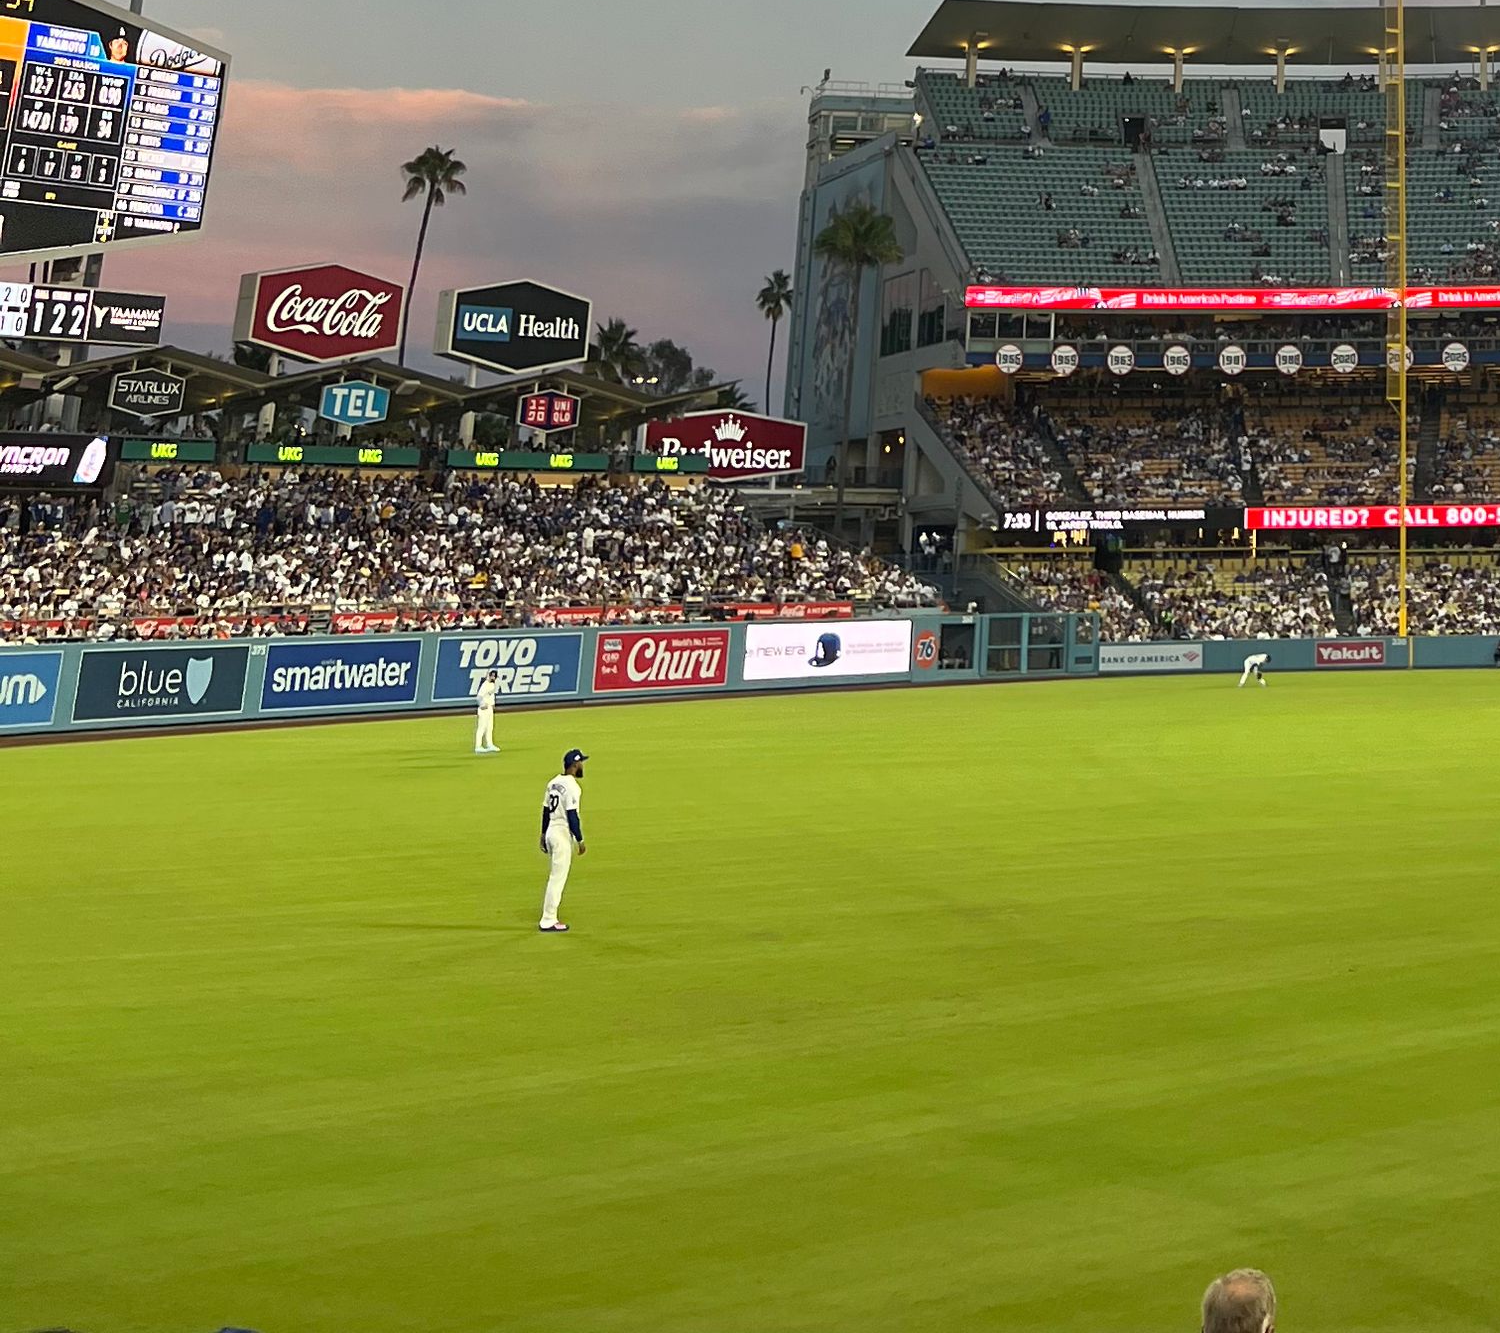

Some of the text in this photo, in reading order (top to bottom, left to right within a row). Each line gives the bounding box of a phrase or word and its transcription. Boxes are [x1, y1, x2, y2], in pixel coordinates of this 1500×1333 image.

[69, 71, 84, 82] ERA
[30, 75, 122, 105] 12-7 2.63 0.90
[60, 114, 79, 133] 139
[97, 119, 113, 138] 34
[4, 287, 28, 303] 2 0
[1143, 293, 1257, 305] Drink in America's Pastime
[1439, 291, 1463, 302] Drink
[1464, 292, 1472, 302] in
[33, 301, 85, 336] 1 2 2
[266, 283, 392, 340] Coca-Cola
[16, 317, 23, 332] 0
[463, 311, 579, 341] UCLA Health
[1054, 353, 1077, 366] 1959
[1109, 354, 1133, 366] 1963
[1165, 354, 1189, 366] 1965
[1221, 353, 1245, 366] 1981
[1333, 353, 1356, 364] 2020
[1388, 352, 1411, 364] 204
[1444, 352, 1467, 364] 2025
[117, 378, 181, 397] STARLUX
[125, 392, 171, 408] AIRLINES
[331, 388, 380, 420] TEL
[554, 400, 570, 411] UNI
[553, 412, 570, 422] QLO
[151, 443, 177, 459] UKG
[278, 446, 303, 462] UKG
[358, 448, 382, 464] UKG
[661, 437, 791, 469] Bdweiser
[475, 452, 499, 468] UKG
[550, 453, 573, 469] UKG
[657, 456, 678, 471] UKG
[1122, 510, 1168, 521] BASEMAN,
[1167, 510, 1205, 520] NUMBER
[1263, 508, 1370, 526] INJURED?
[1384, 507, 1439, 525] CALL
[460, 638, 537, 668] TOYO
[916, 636, 938, 660] 76
[1319, 645, 1382, 661] Yakult
[627, 637, 721, 682] Churu
[1101, 653, 1181, 664] BANK OF AMERICA
[118, 660, 183, 696] blue
[272, 658, 409, 693] smartwater
[469, 665, 553, 695] TRES
[117, 696, 179, 709] CALIFORNIA
